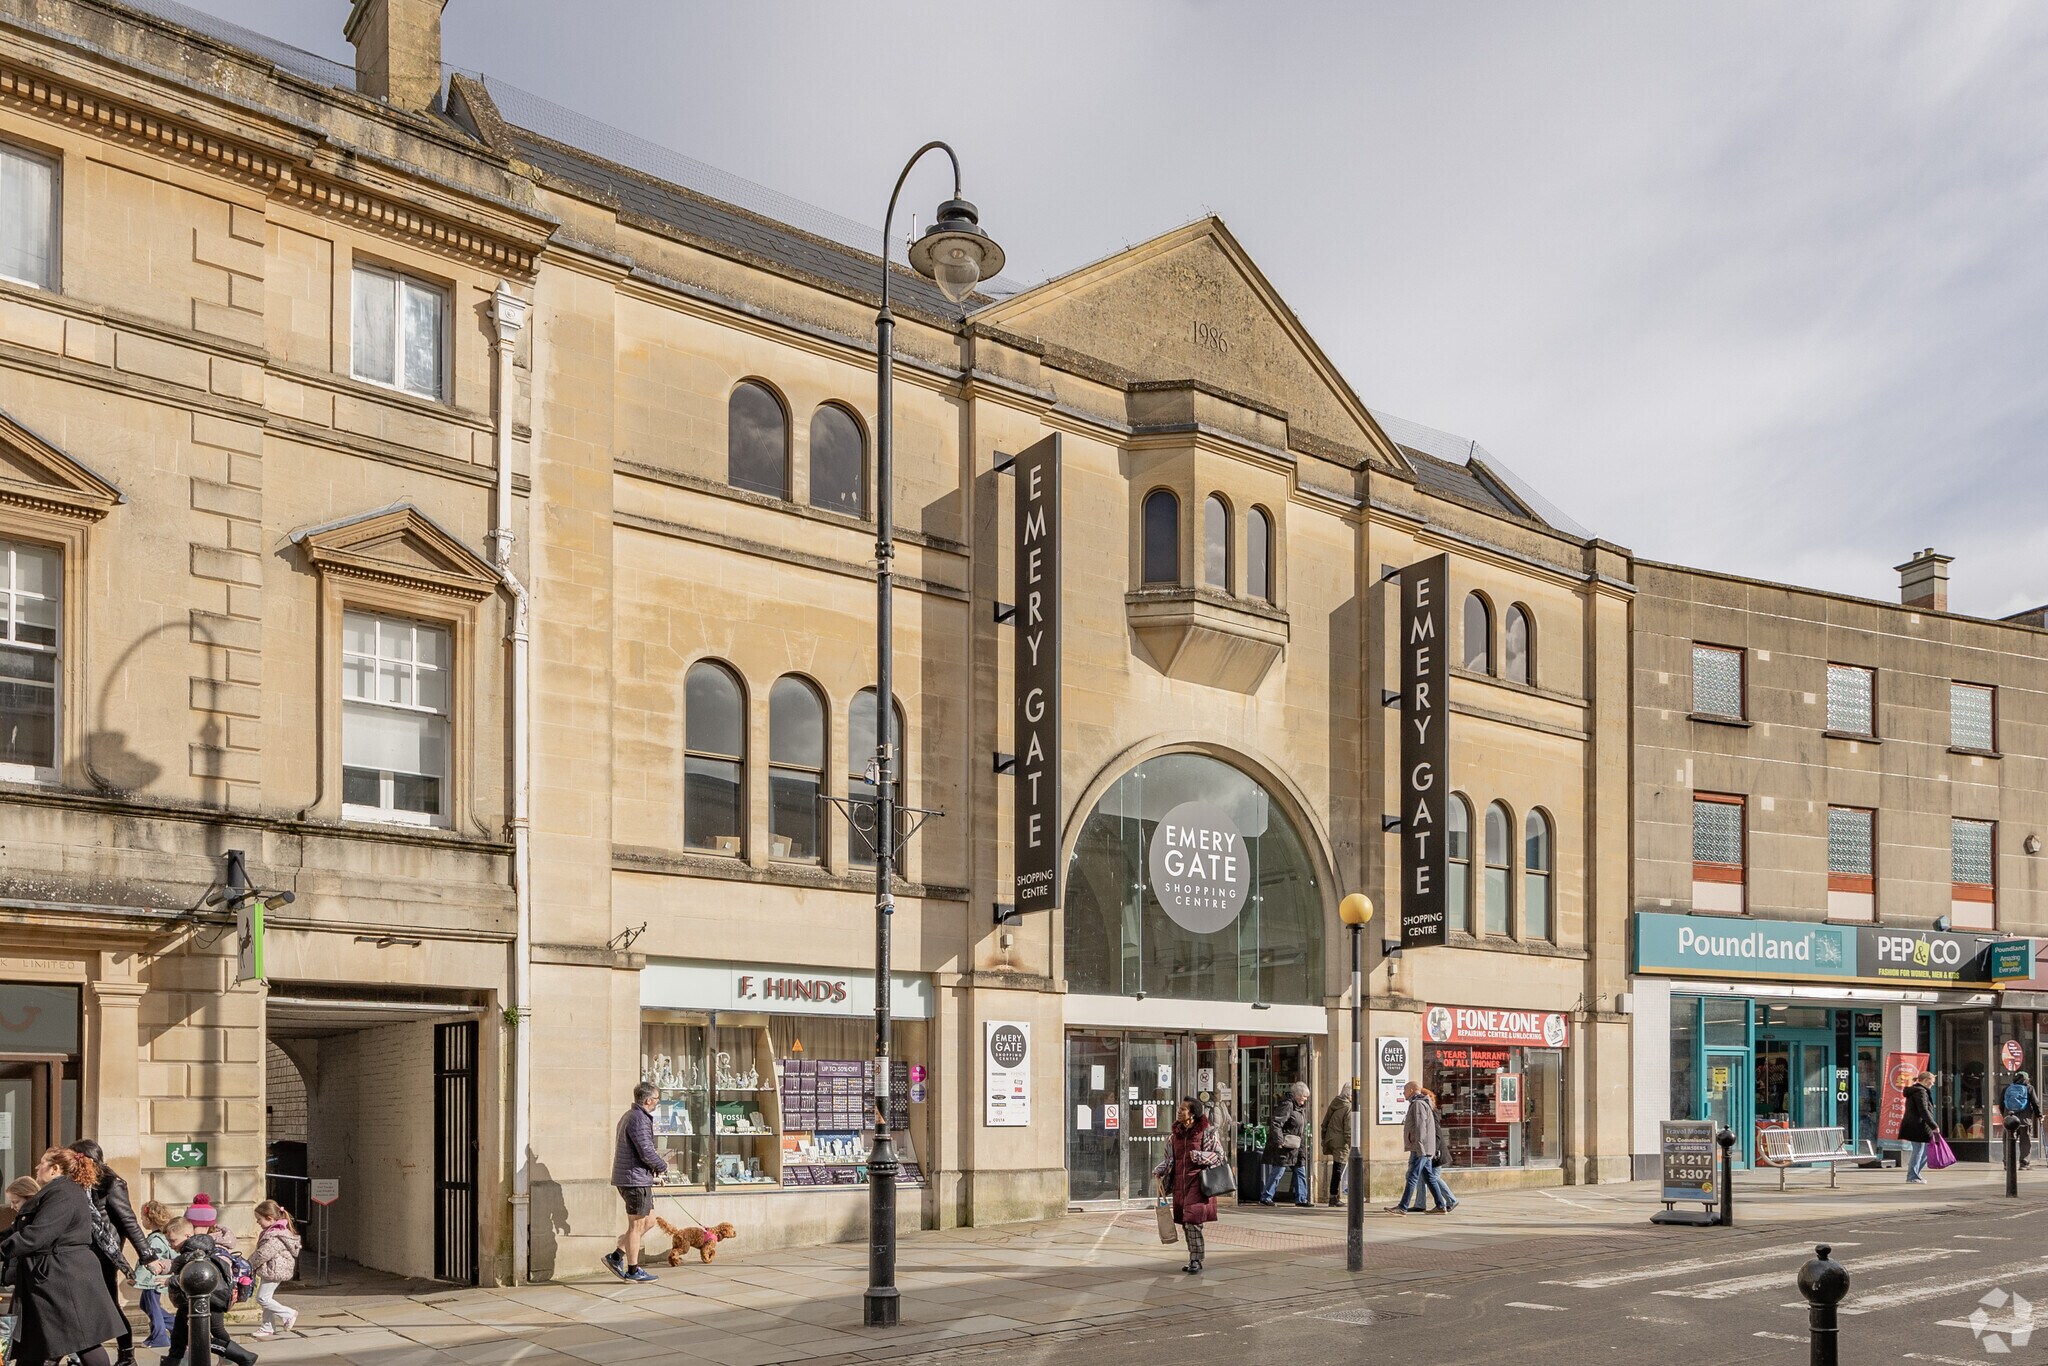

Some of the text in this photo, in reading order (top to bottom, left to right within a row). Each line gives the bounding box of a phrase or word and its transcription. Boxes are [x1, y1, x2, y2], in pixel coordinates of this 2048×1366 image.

[1193, 320, 1228, 353] 1986
[1024, 464, 1047, 848] EMERY GATE
[1410, 577, 1435, 895] EMERY GATE
[1166, 824, 1236, 853] EMERY
[1164, 849, 1237, 882] GATE
[1016, 869, 1053, 886] SHOPPING
[1021, 884, 1048, 899] CENTRE
[1164, 882, 1236, 898] SHOPPING
[1175, 895, 1227, 909] CENTRE
[1403, 912, 1443, 926] SHOPPING
[1408, 925, 1437, 937] CENTRE
[1678, 926, 1810, 961] Poundland
[1994, 945, 2026, 953] Poundland
[22, 960, 75, 970] LIMITED
[1878, 968, 1900, 976] FASHION
[1900, 969, 1910, 977] FOR
[1931, 970, 1943, 978] MEN
[742, 976, 847, 1001] F. HINDS
[1868, 1022, 1880, 1031] PEP
[995, 1034, 1022, 1042] EMERY
[1488, 1031, 1508, 1039] CENTRE
[995, 1042, 1022, 1052] GATE
[1384, 1047, 1403, 1055] EMERY
[1384, 1054, 1403, 1062] GATE
[1436, 1050, 1511, 1060] 5 YEARS WARRANTY
[1443, 1059, 1500, 1068] ON ALL PHONES
[1836, 1070, 1849, 1079] PEP
[1837, 1092, 1849, 1101] CO
[1687, 1128, 1711, 1136] Money
[1668, 1154, 1711, 1165] 1.1217
[1668, 1169, 1712, 1179] 1.3307
